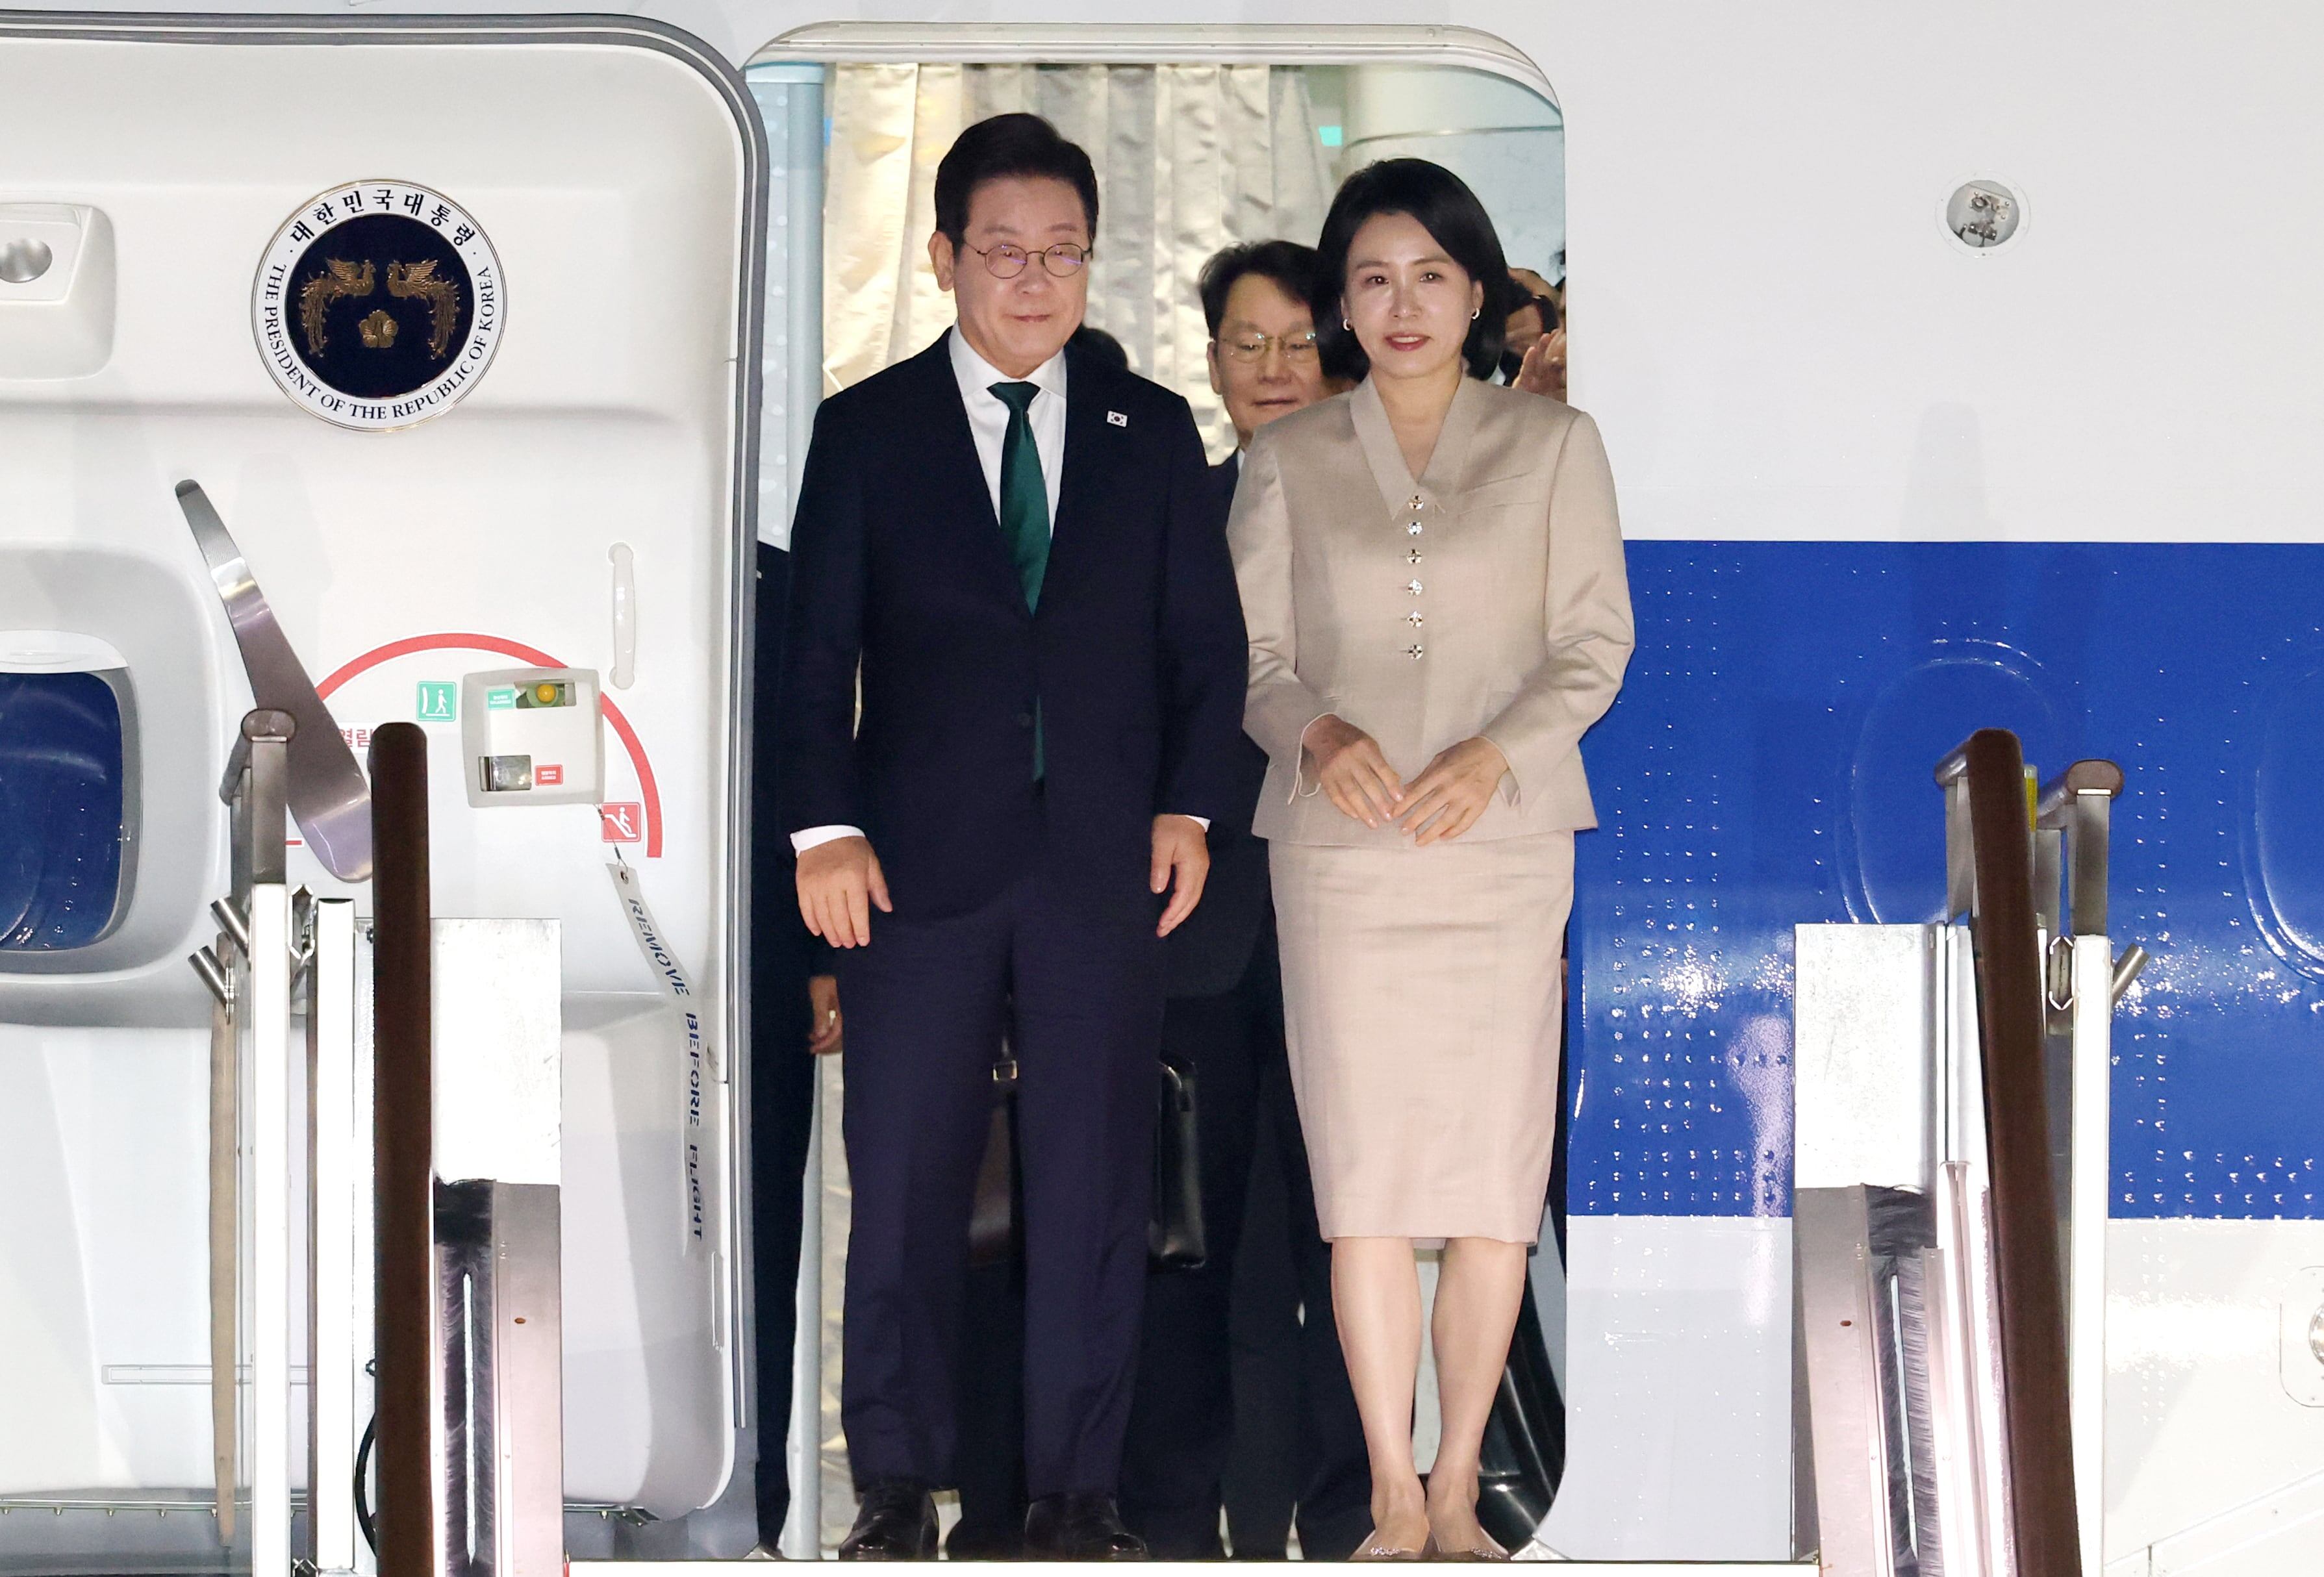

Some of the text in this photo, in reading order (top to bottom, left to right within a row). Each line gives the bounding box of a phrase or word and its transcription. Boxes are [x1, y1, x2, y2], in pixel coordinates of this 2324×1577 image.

[265, 263, 494, 419] THE PRESIDENT OF THE REPUBLIC OF KOREA
[628, 898, 702, 1241] REMOVE BEFORE FLIGHT
